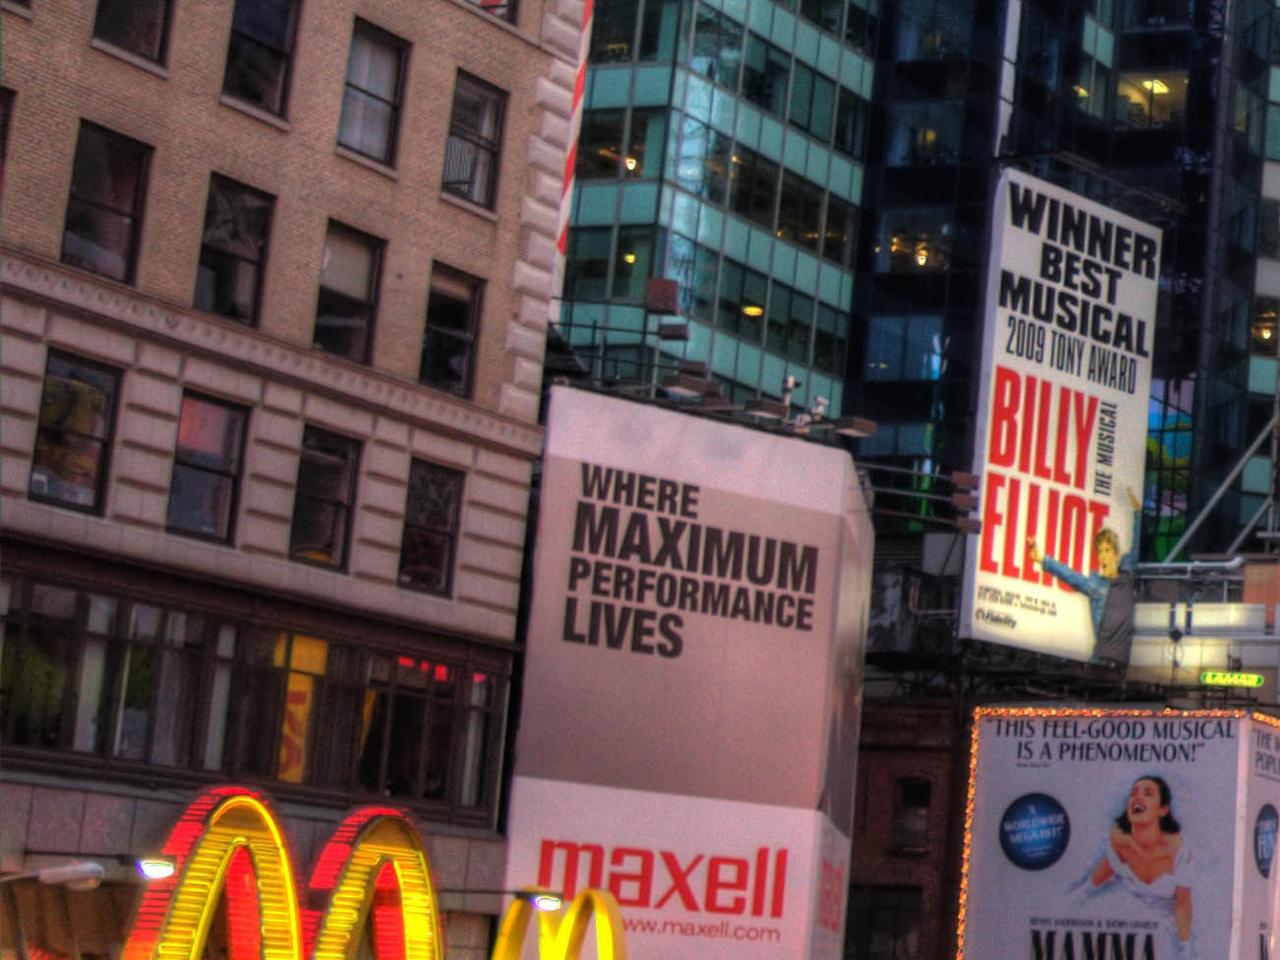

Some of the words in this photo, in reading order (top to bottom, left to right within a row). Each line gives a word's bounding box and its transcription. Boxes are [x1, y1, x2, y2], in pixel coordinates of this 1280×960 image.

[1008, 181, 1158, 280] WINNER
[1040, 242, 1122, 305] BEST
[999, 269, 1148, 358] MUSICAL
[1006, 316, 1046, 364] 2009
[1050, 330, 1086, 378] TONY
[1088, 345, 1137, 394] AWARD
[988, 365, 1099, 491] BILLY
[1097, 401, 1118, 466] MUSICAL
[581, 462, 700, 519] WHERE
[1094, 471, 1112, 497] THE
[571, 501, 819, 594] MAXIMUM
[979, 468, 1110, 593] ELLIOT
[562, 597, 685, 658] LIVES
[568, 557, 814, 631] PERFORMANCE
[1017, 741, 1033, 761] IS
[1038, 742, 1052, 761] A
[1042, 720, 1146, 741] FEEL-GOOD
[1152, 720, 1235, 741] MUSICAL
[537, 839, 788, 918] maxell
